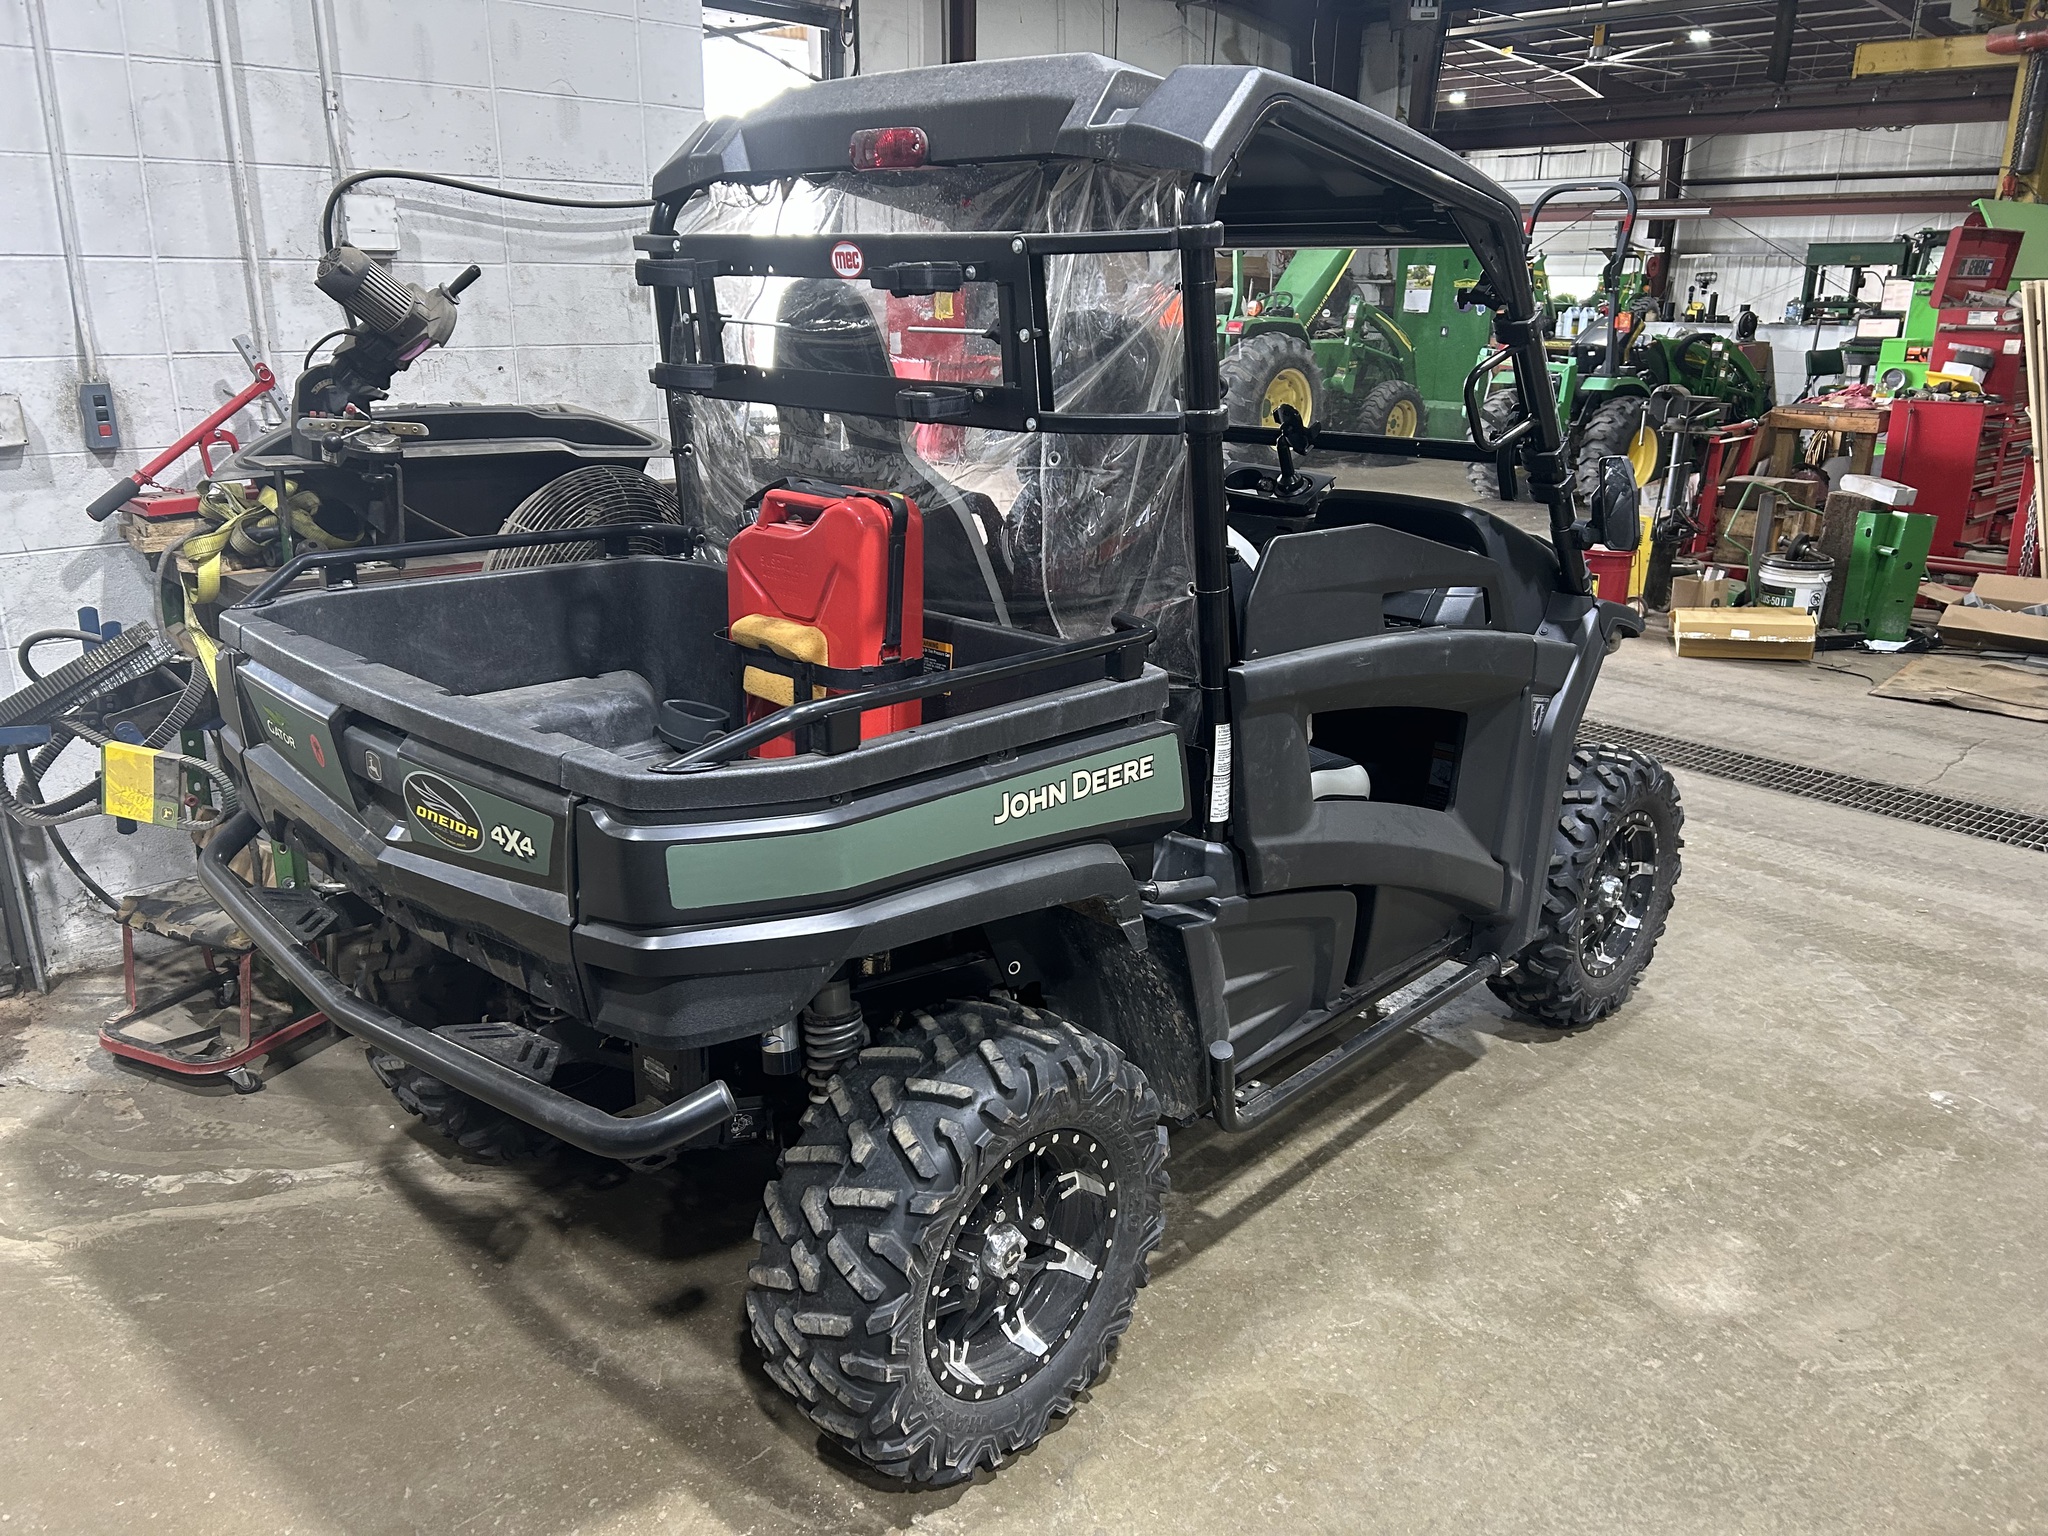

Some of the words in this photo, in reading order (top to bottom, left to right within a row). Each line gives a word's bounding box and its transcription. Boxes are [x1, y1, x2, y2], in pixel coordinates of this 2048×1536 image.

[267, 719, 296, 750] GATOR
[993, 779, 1067, 825] JOHN
[1071, 754, 1154, 801] DEERE
[416, 805, 479, 840] ONEIDA
